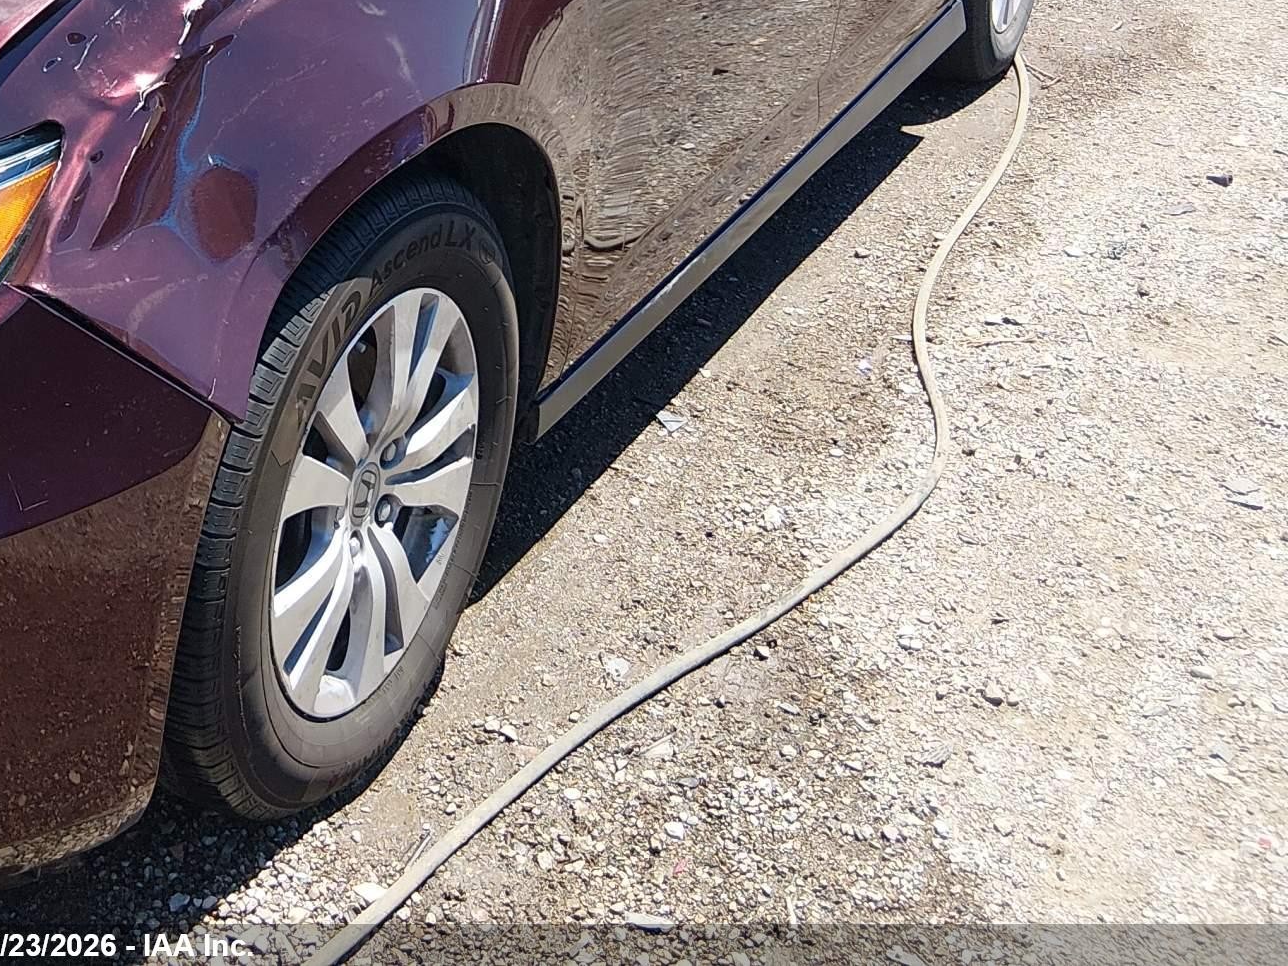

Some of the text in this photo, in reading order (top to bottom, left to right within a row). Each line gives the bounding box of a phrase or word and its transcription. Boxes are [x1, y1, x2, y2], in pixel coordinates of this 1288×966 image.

[295, 219, 477, 432] AVID Ascend LX
